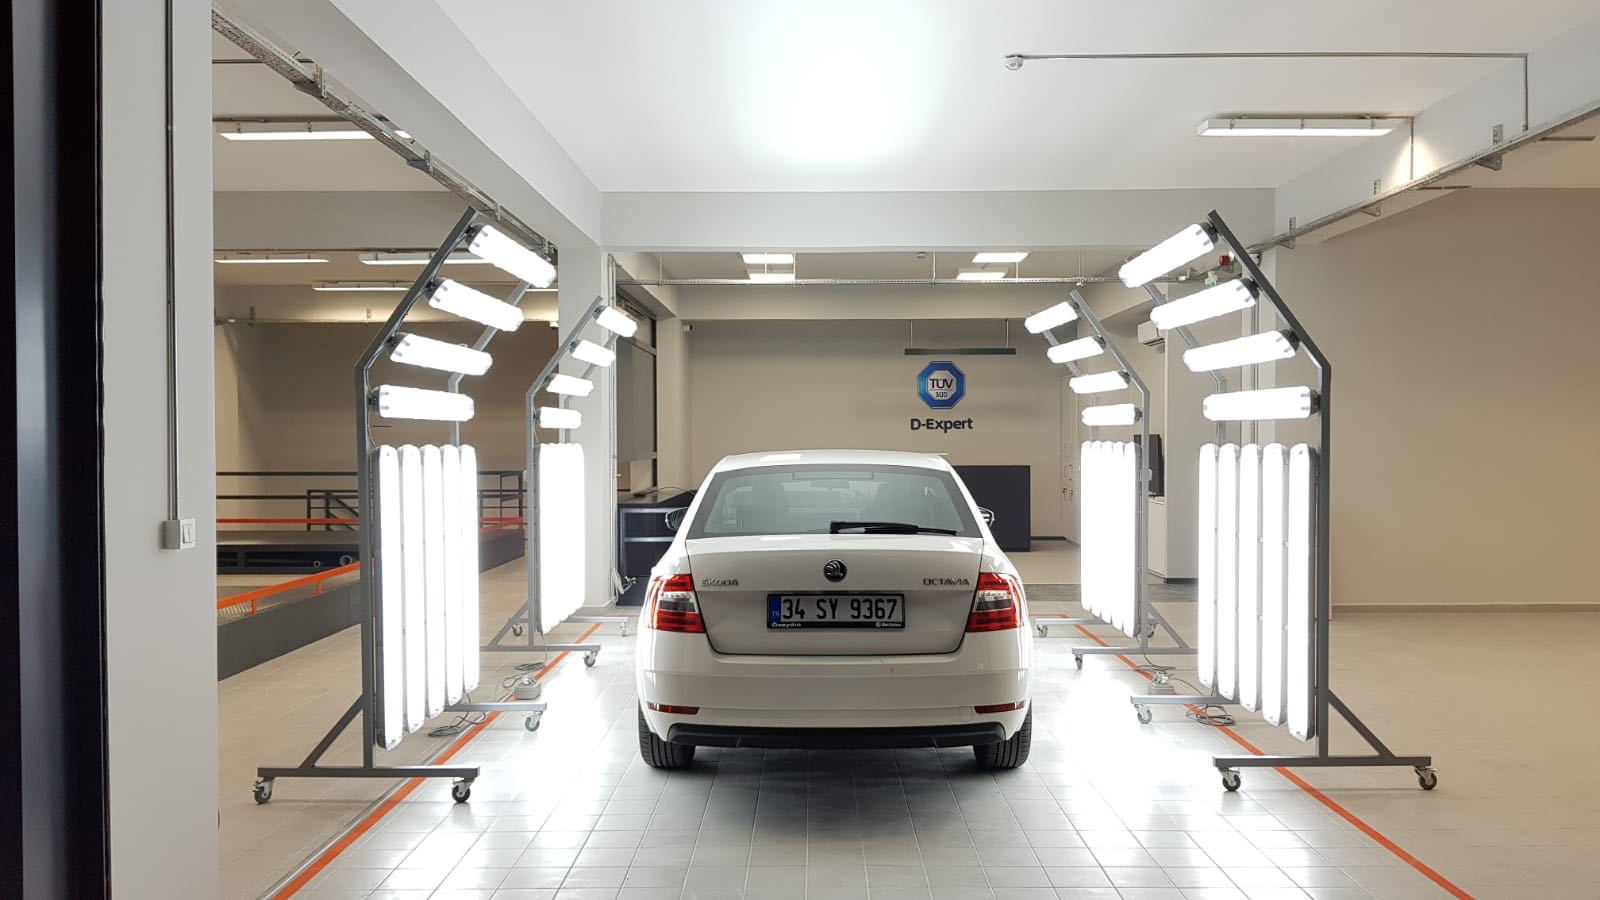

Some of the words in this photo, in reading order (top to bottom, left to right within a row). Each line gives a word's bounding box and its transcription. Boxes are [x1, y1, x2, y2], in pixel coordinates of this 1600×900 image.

[929, 378, 953, 389] TÜV
[910, 418, 974, 434] D-Expert
[922, 577, 970, 586] OCTAVIA
[782, 598, 806, 619] 34
[816, 598, 839, 619] SY
[850, 598, 898, 619] 9367
